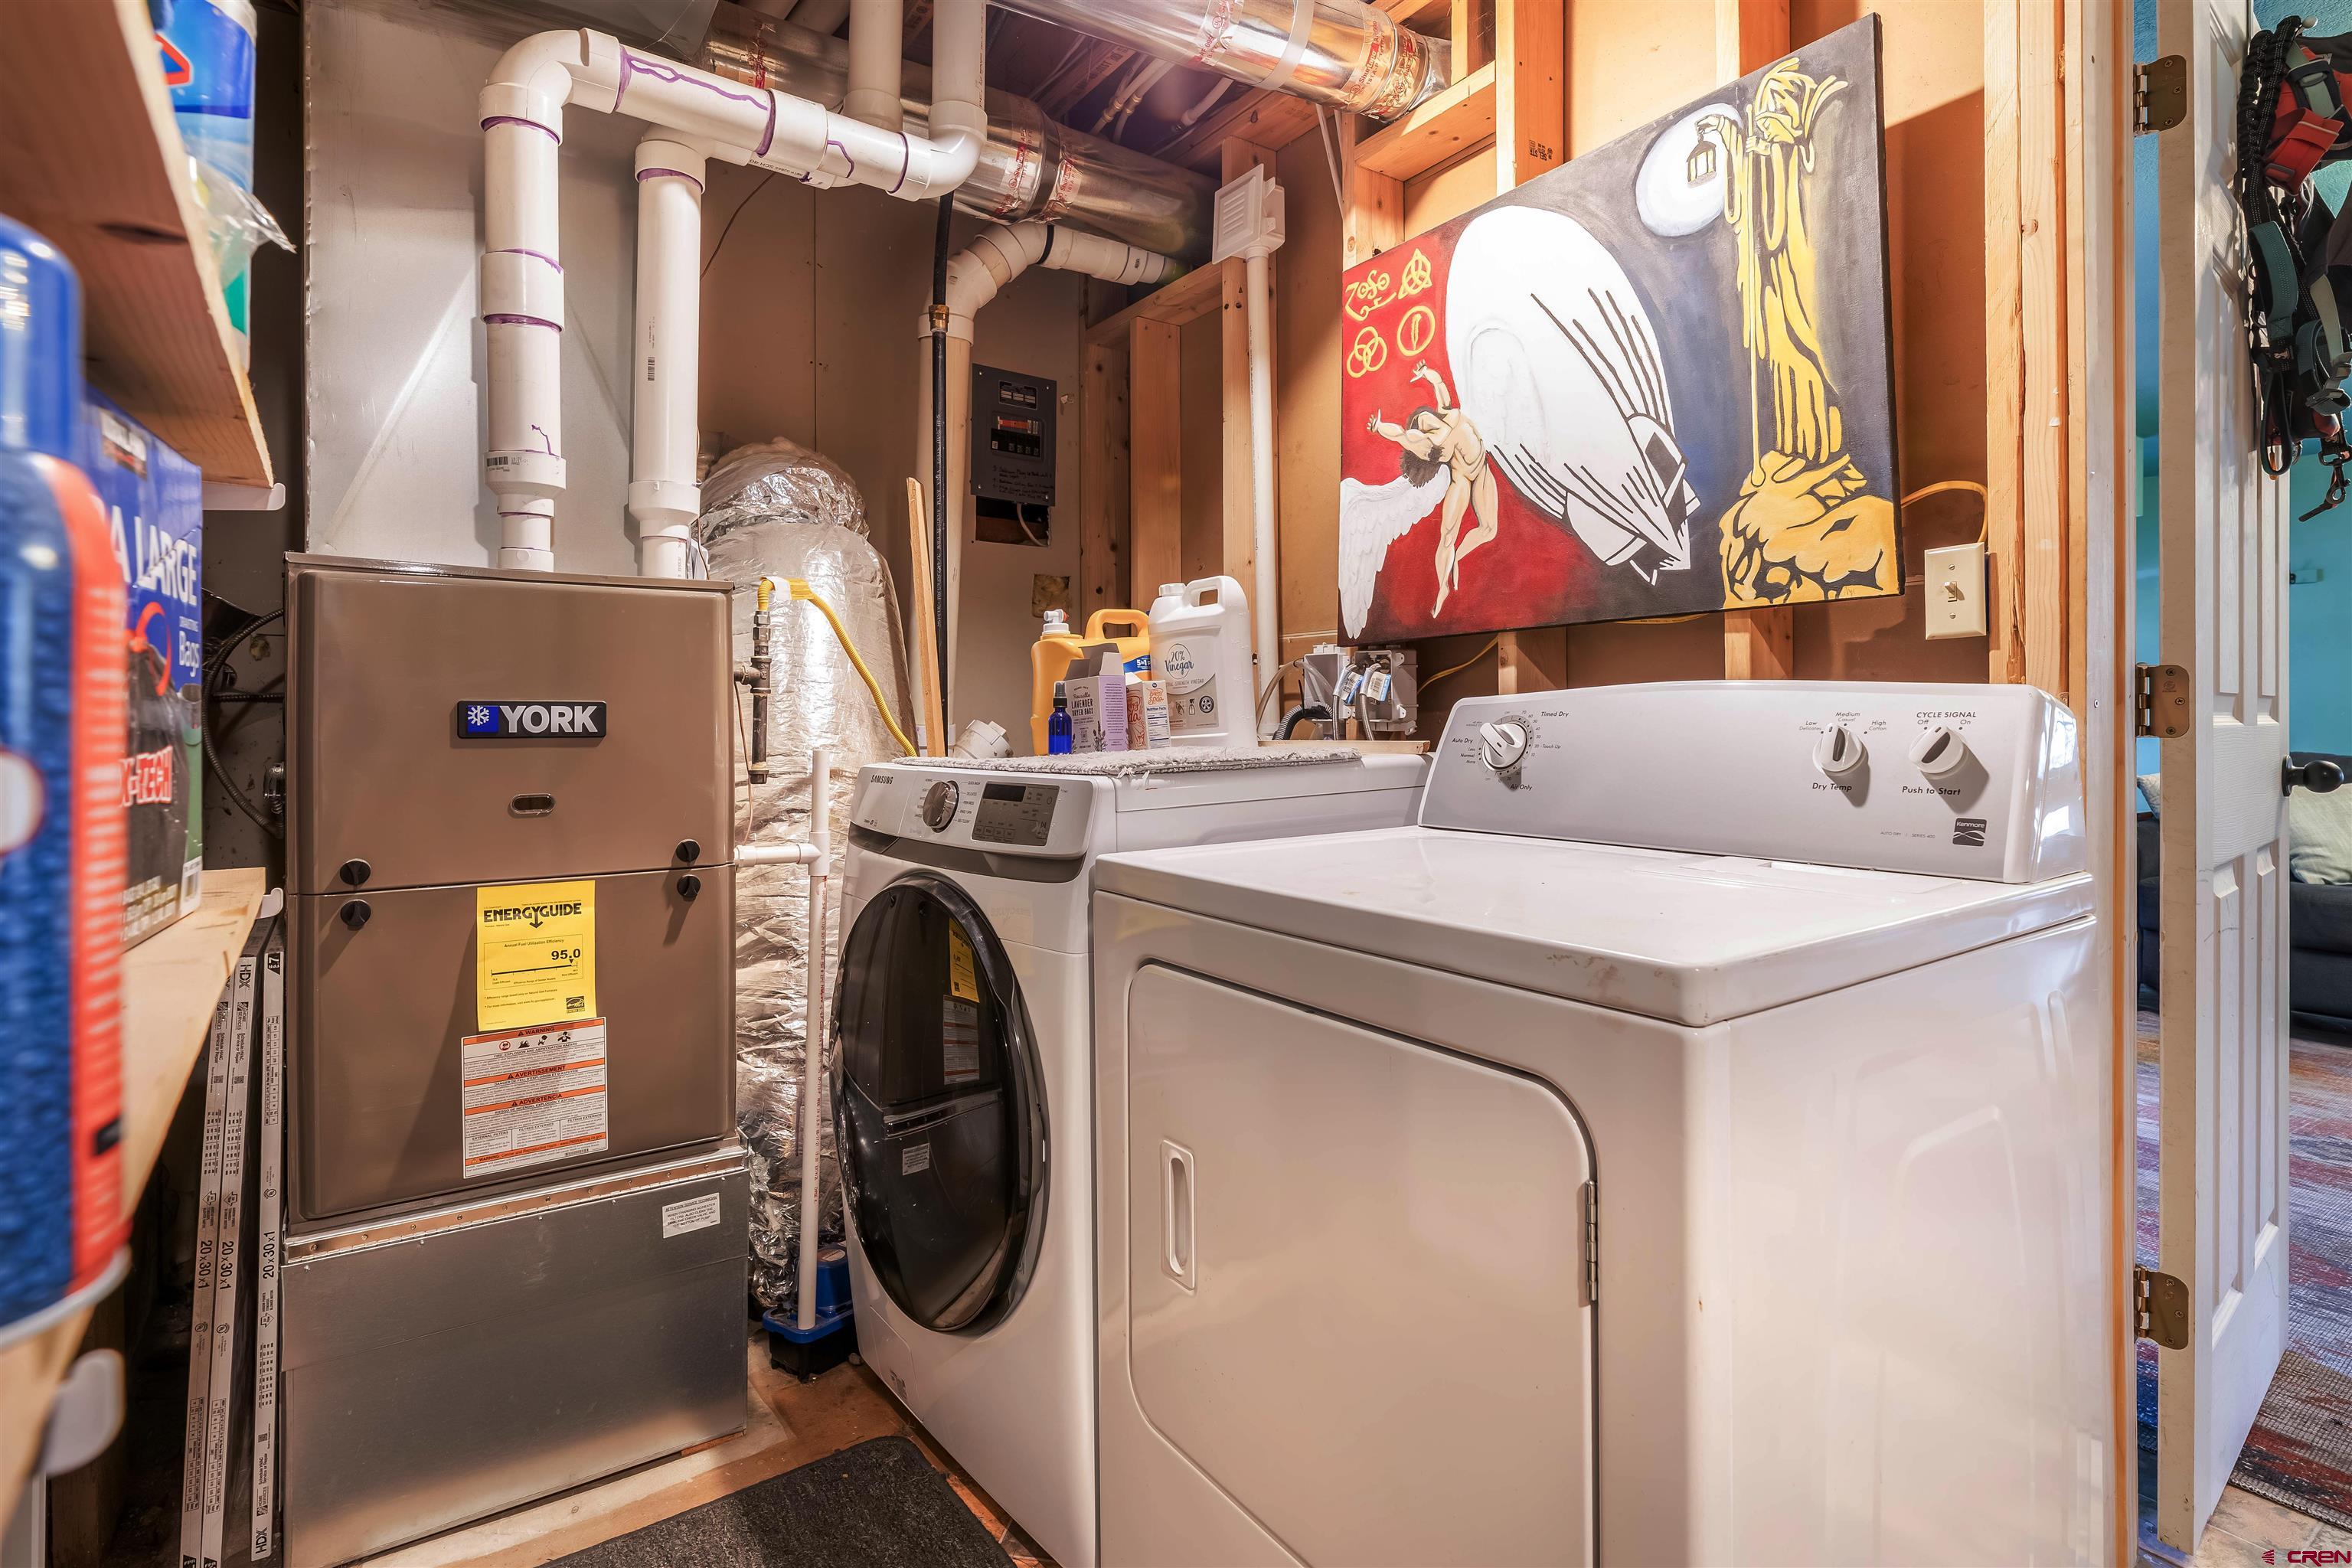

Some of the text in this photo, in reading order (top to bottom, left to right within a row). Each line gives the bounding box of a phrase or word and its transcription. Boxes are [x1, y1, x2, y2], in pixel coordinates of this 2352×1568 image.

[760, 161, 774, 169] SCH
[134, 516, 198, 606] LARGE
[179, 630, 200, 678] Bags
[1171, 650, 1185, 662] 20%
[1165, 660, 1194, 675] Vinegar
[1072, 698, 1093, 709] LAVENDER
[499, 705, 598, 733] YORK
[871, 775, 894, 785] SAMSUNG
[1812, 782, 1853, 792] Dry Temp
[1938, 787, 1961, 795] Start
[484, 903, 582, 925] ENERGYGUIDE
[550, 949, 581, 961] 95.0
[239, 964, 252, 988] HDX
[525, 1027, 555, 1035] WARNING
[515, 1065, 566, 1078] AVERTISSEMENT
[519, 1093, 563, 1105] ADVERTENCIA
[255, 1527, 268, 1554] HDX
